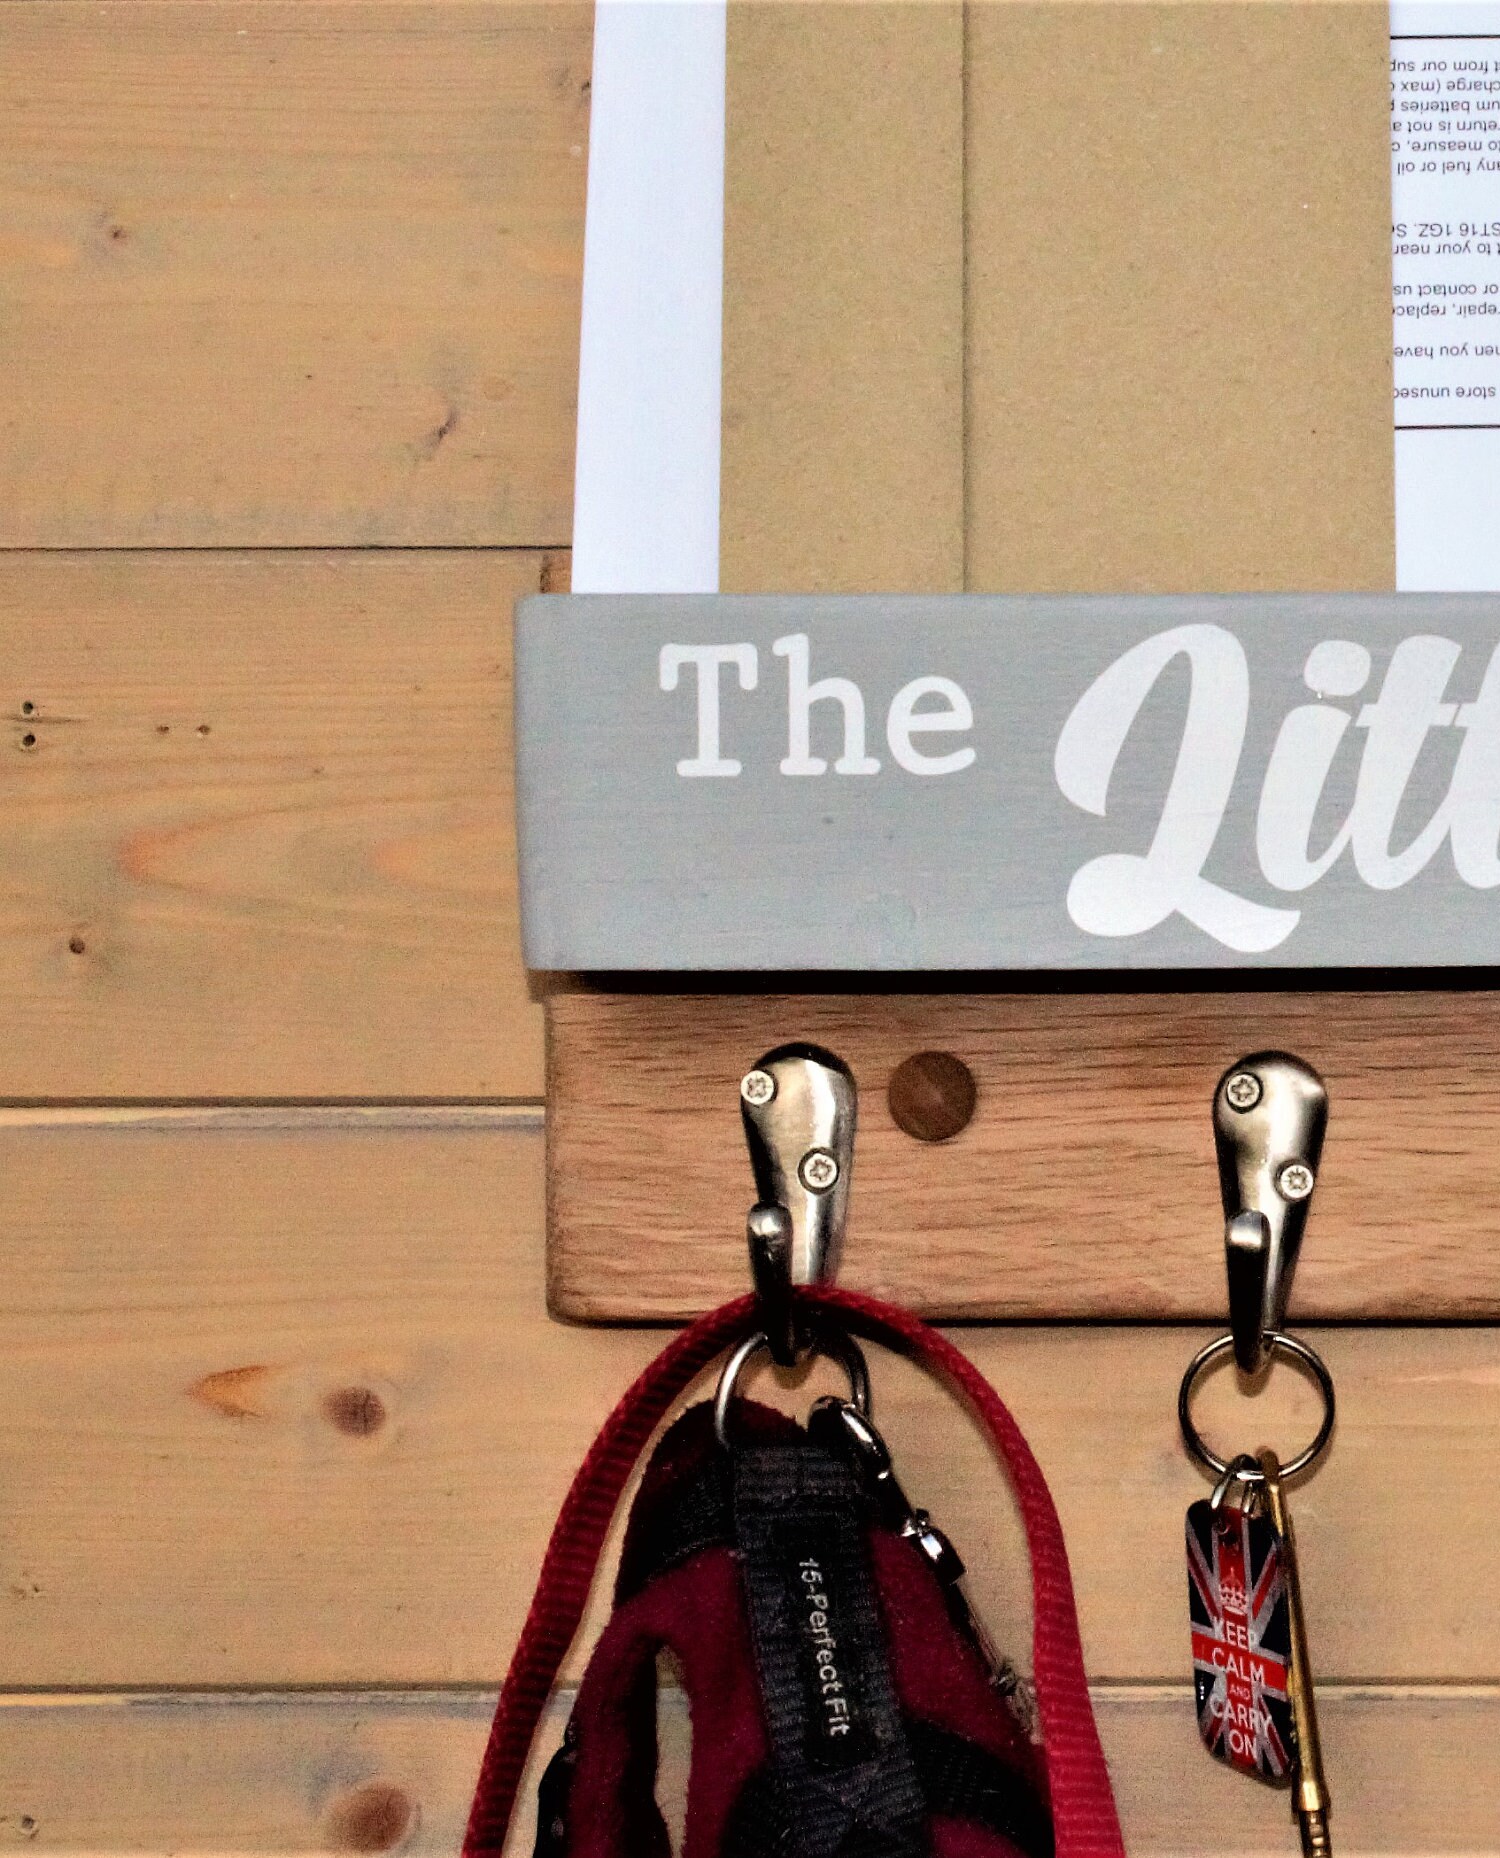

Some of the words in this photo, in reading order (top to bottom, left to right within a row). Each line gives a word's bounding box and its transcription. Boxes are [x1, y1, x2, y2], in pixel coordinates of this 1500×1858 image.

[1397, 161, 1416, 177] oil
[1420, 161, 1437, 174] or
[1442, 161, 1471, 177] fuel
[1391, 301, 1447, 321] replac
[1394, 346, 1434, 362] have
[1439, 342, 1469, 358] you
[1455, 386, 1497, 401] store
[658, 632, 977, 777] The
[1212, 1615, 1260, 1654] KEEP
[1211, 1647, 1266, 1688] CALM
[1228, 1683, 1251, 1700] AND
[1210, 1692, 1273, 1738] CARRY
[1228, 1728, 1258, 1760] ON
